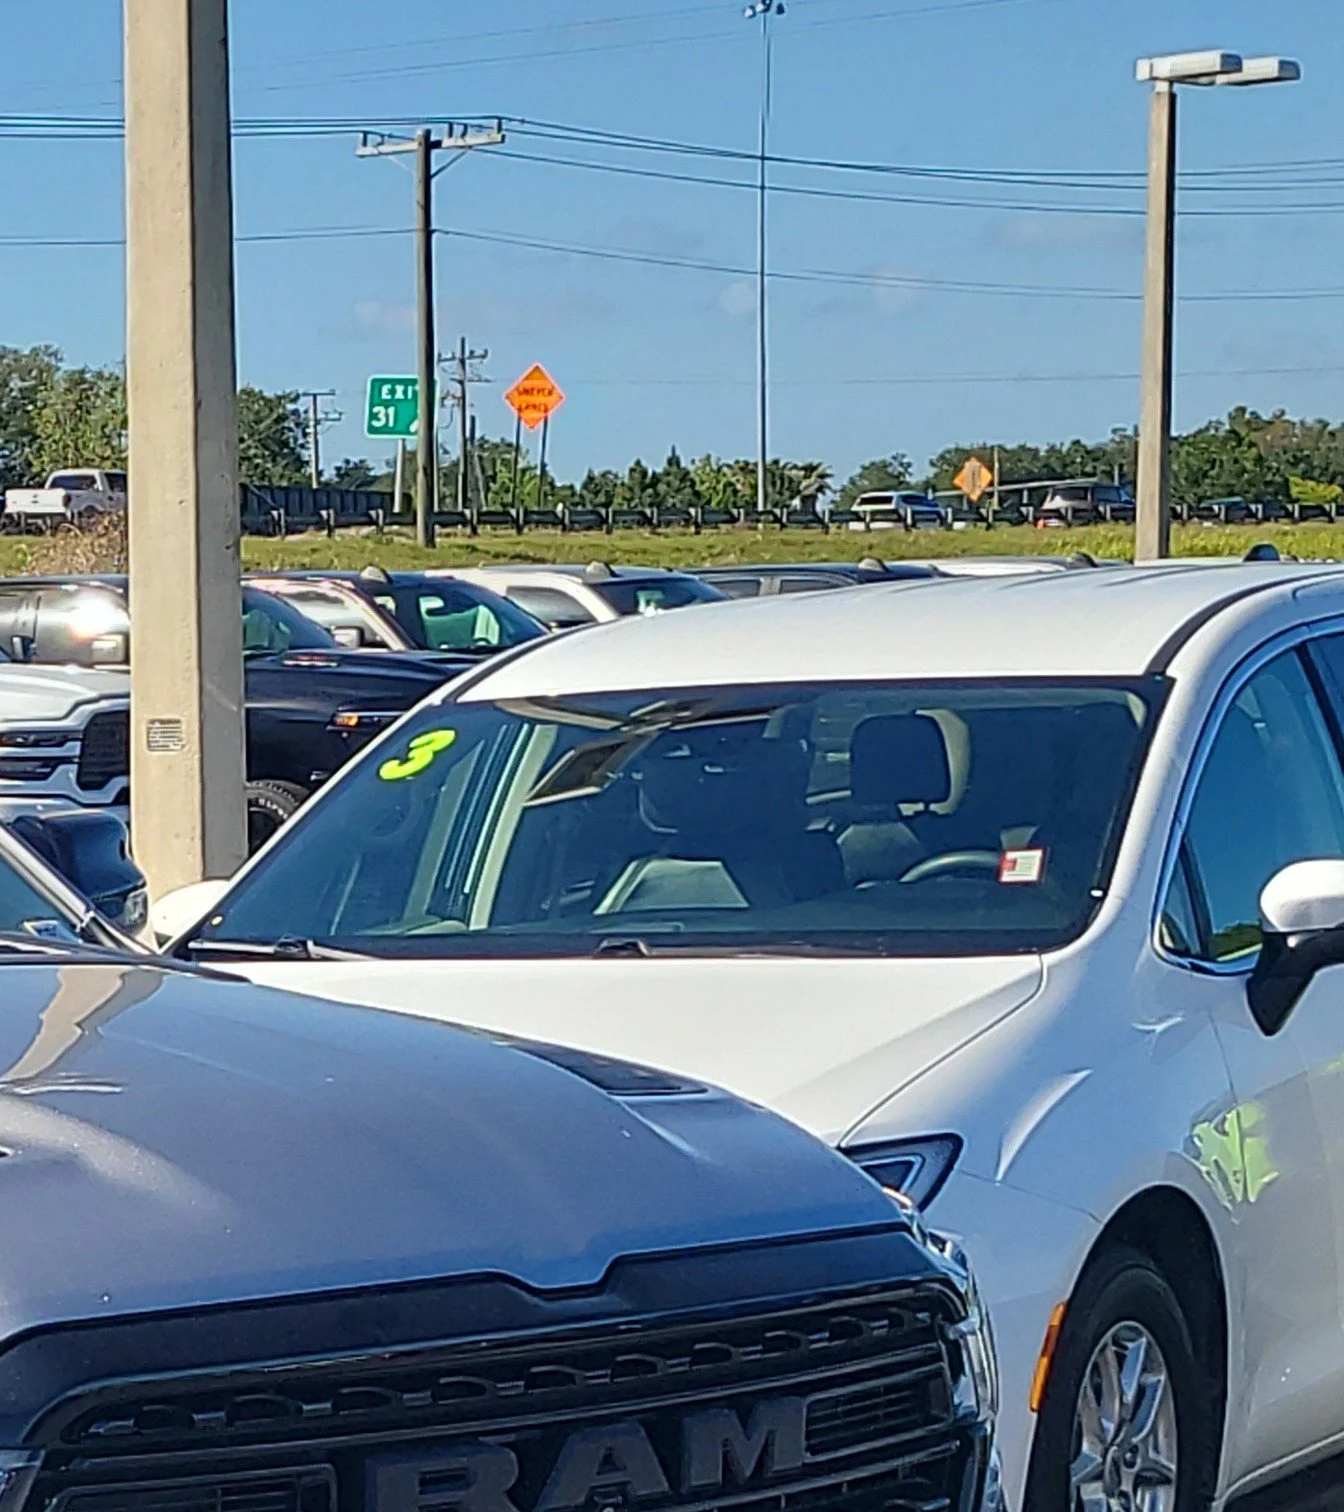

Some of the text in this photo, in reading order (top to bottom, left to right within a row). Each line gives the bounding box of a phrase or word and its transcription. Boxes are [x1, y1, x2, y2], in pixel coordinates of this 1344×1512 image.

[381, 384, 419, 400] EXI
[371, 405, 395, 428] 31
[379, 729, 456, 780] 3
